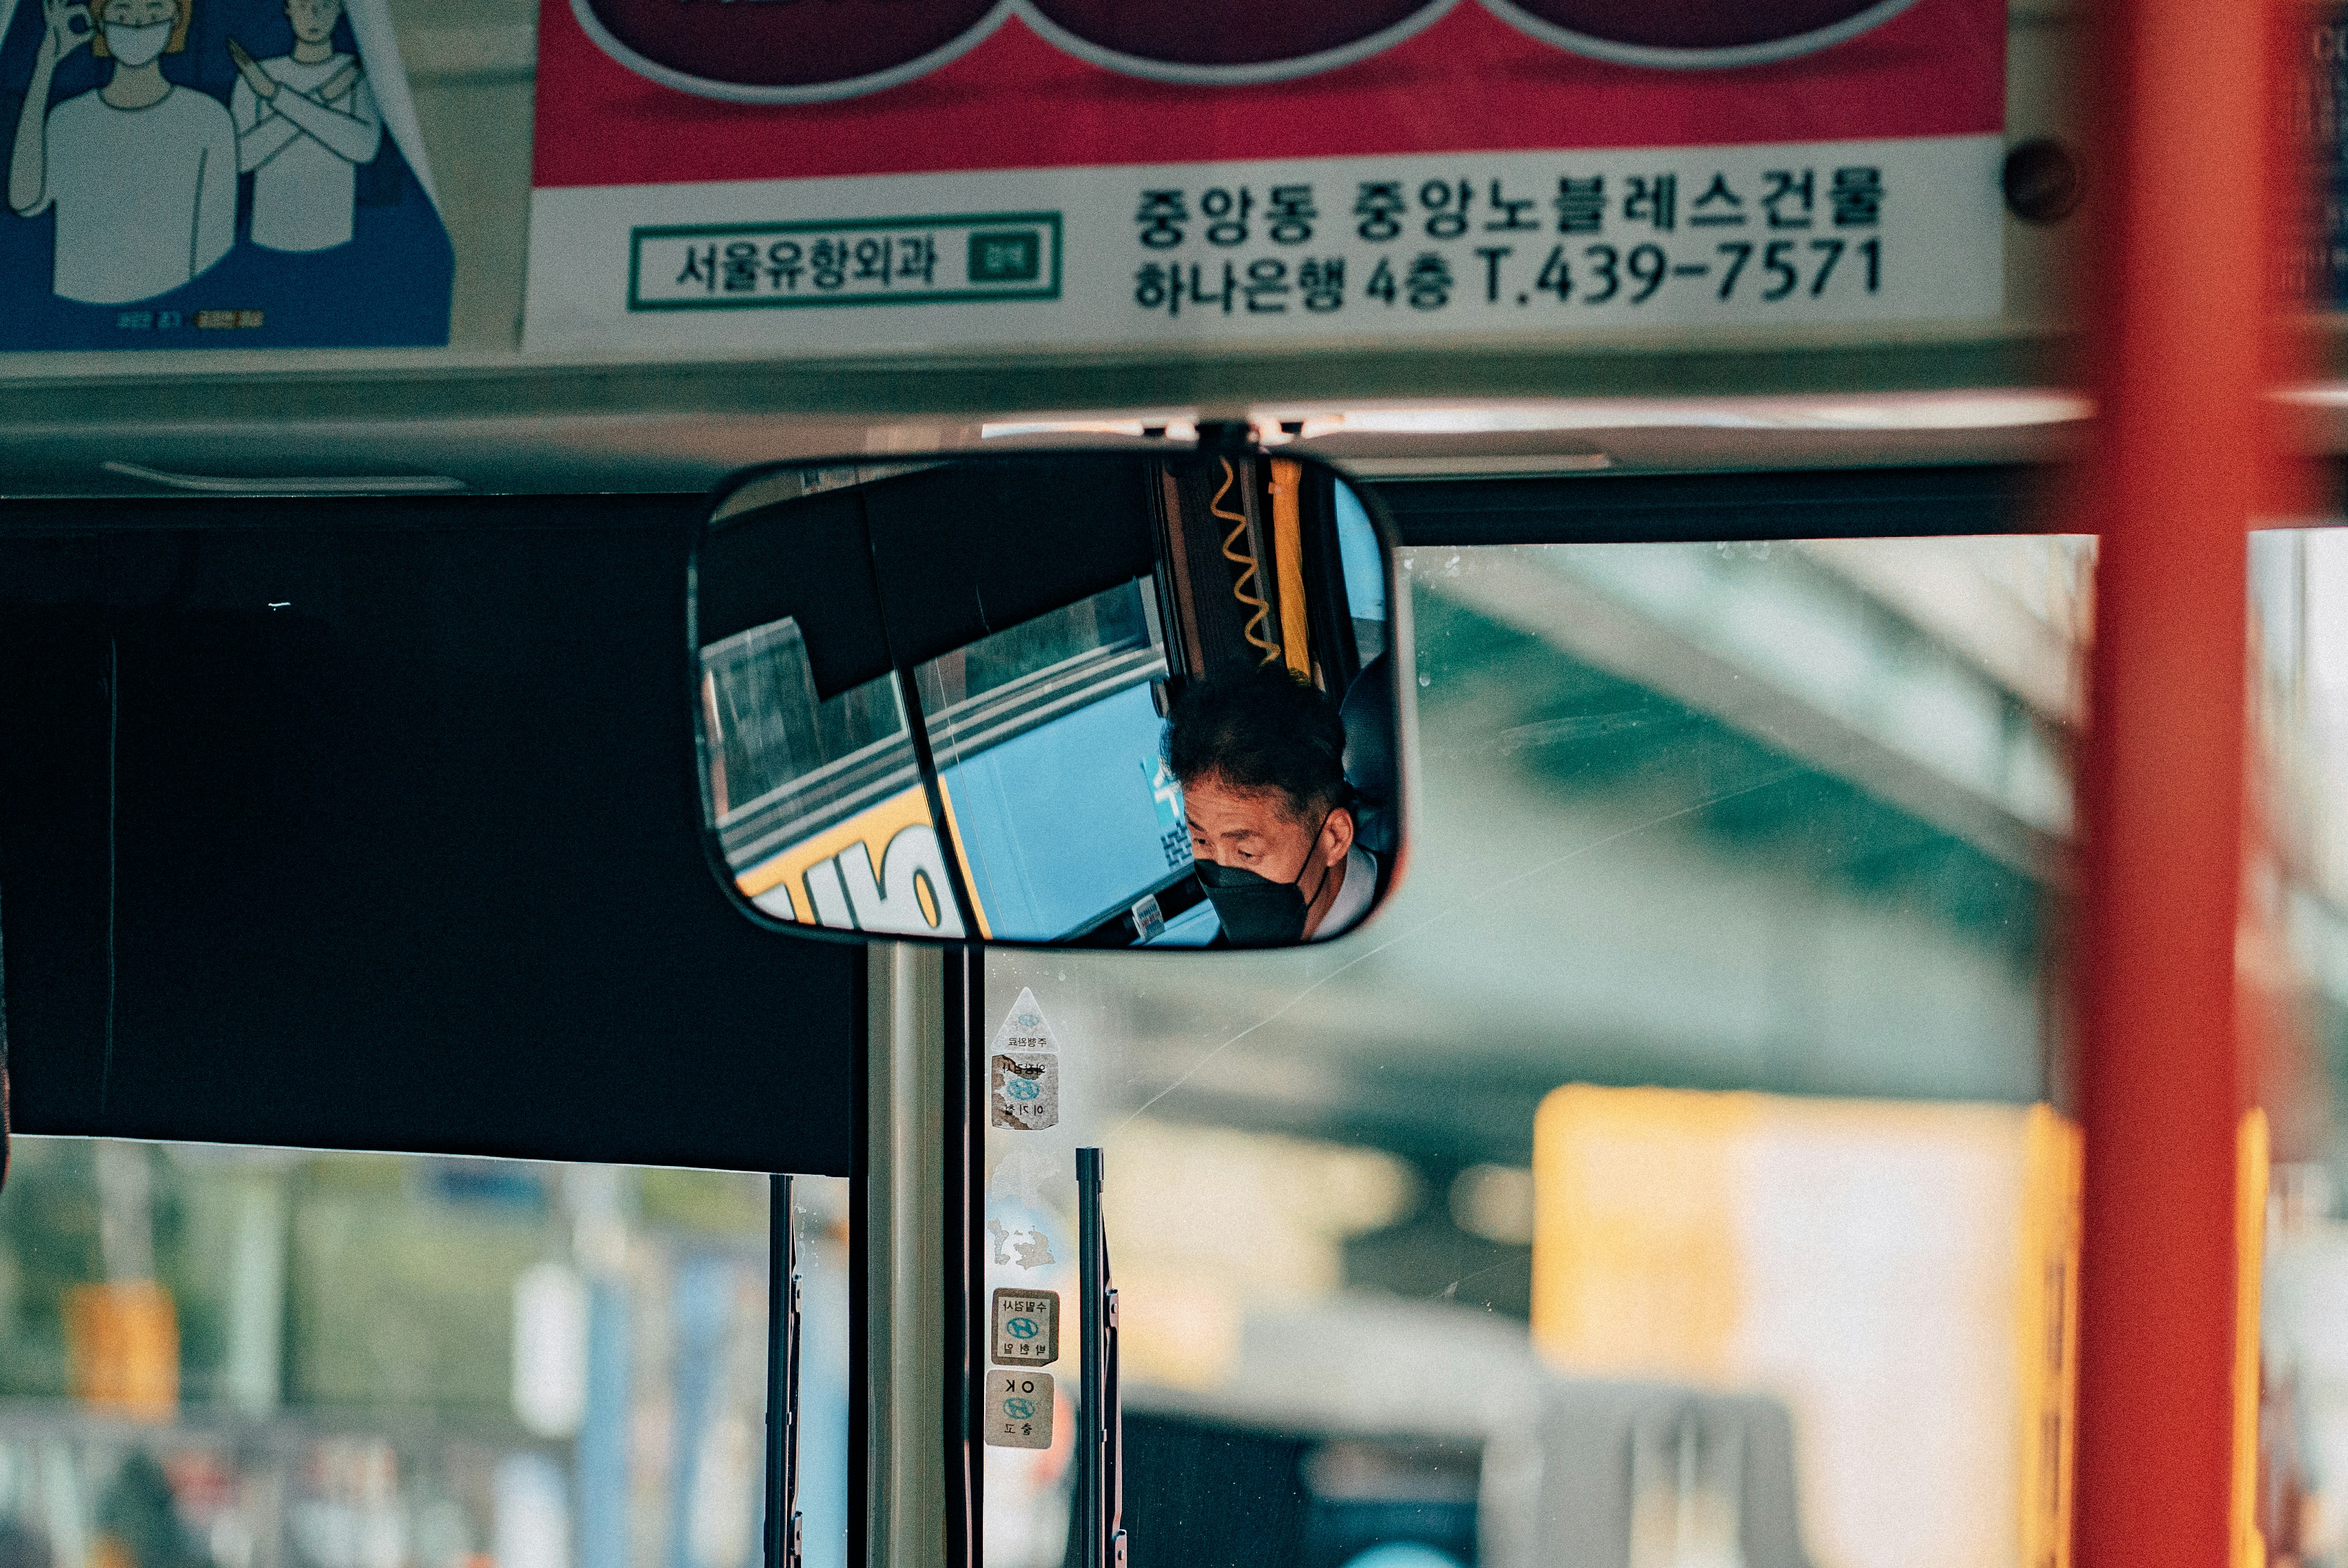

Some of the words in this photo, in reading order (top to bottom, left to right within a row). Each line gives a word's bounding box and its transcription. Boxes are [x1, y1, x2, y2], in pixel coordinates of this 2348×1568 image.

[1135, 183, 1319, 250] 중앙동
[1353, 166, 1886, 243] 중앙노블레스건물
[676, 234, 937, 293] 서울유항외과
[1135, 256, 1346, 317] 하나은행
[1366, 251, 1454, 311] 4층
[1474, 238, 1880, 306] T.439-7571
